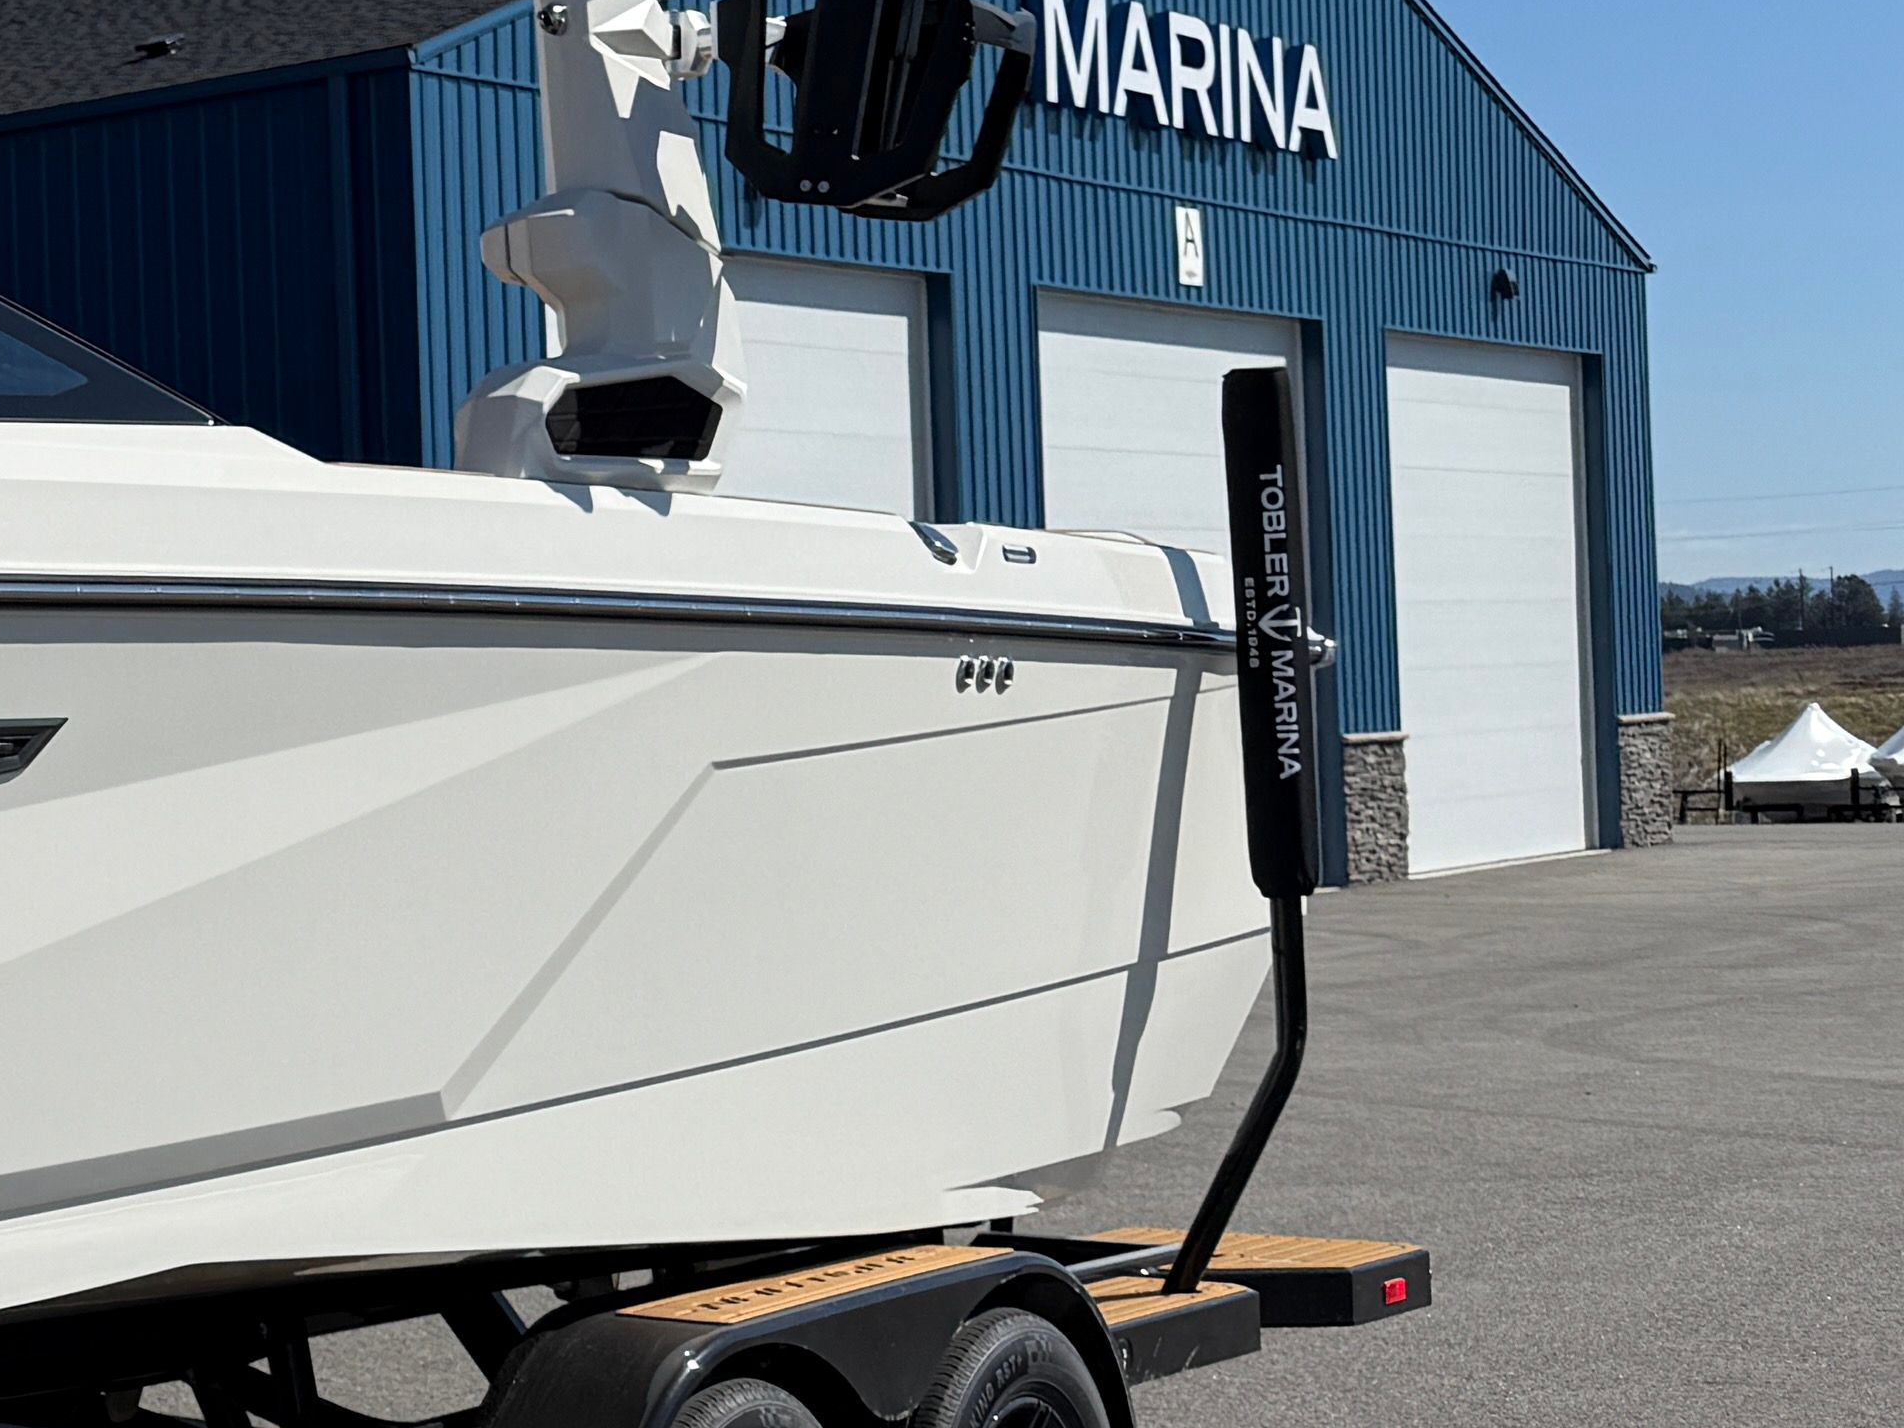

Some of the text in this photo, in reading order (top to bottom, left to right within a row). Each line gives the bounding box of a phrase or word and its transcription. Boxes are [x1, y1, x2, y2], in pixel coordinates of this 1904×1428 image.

[1183, 211, 1200, 260] A
[1258, 464, 1302, 780] TOBLER MARINA
